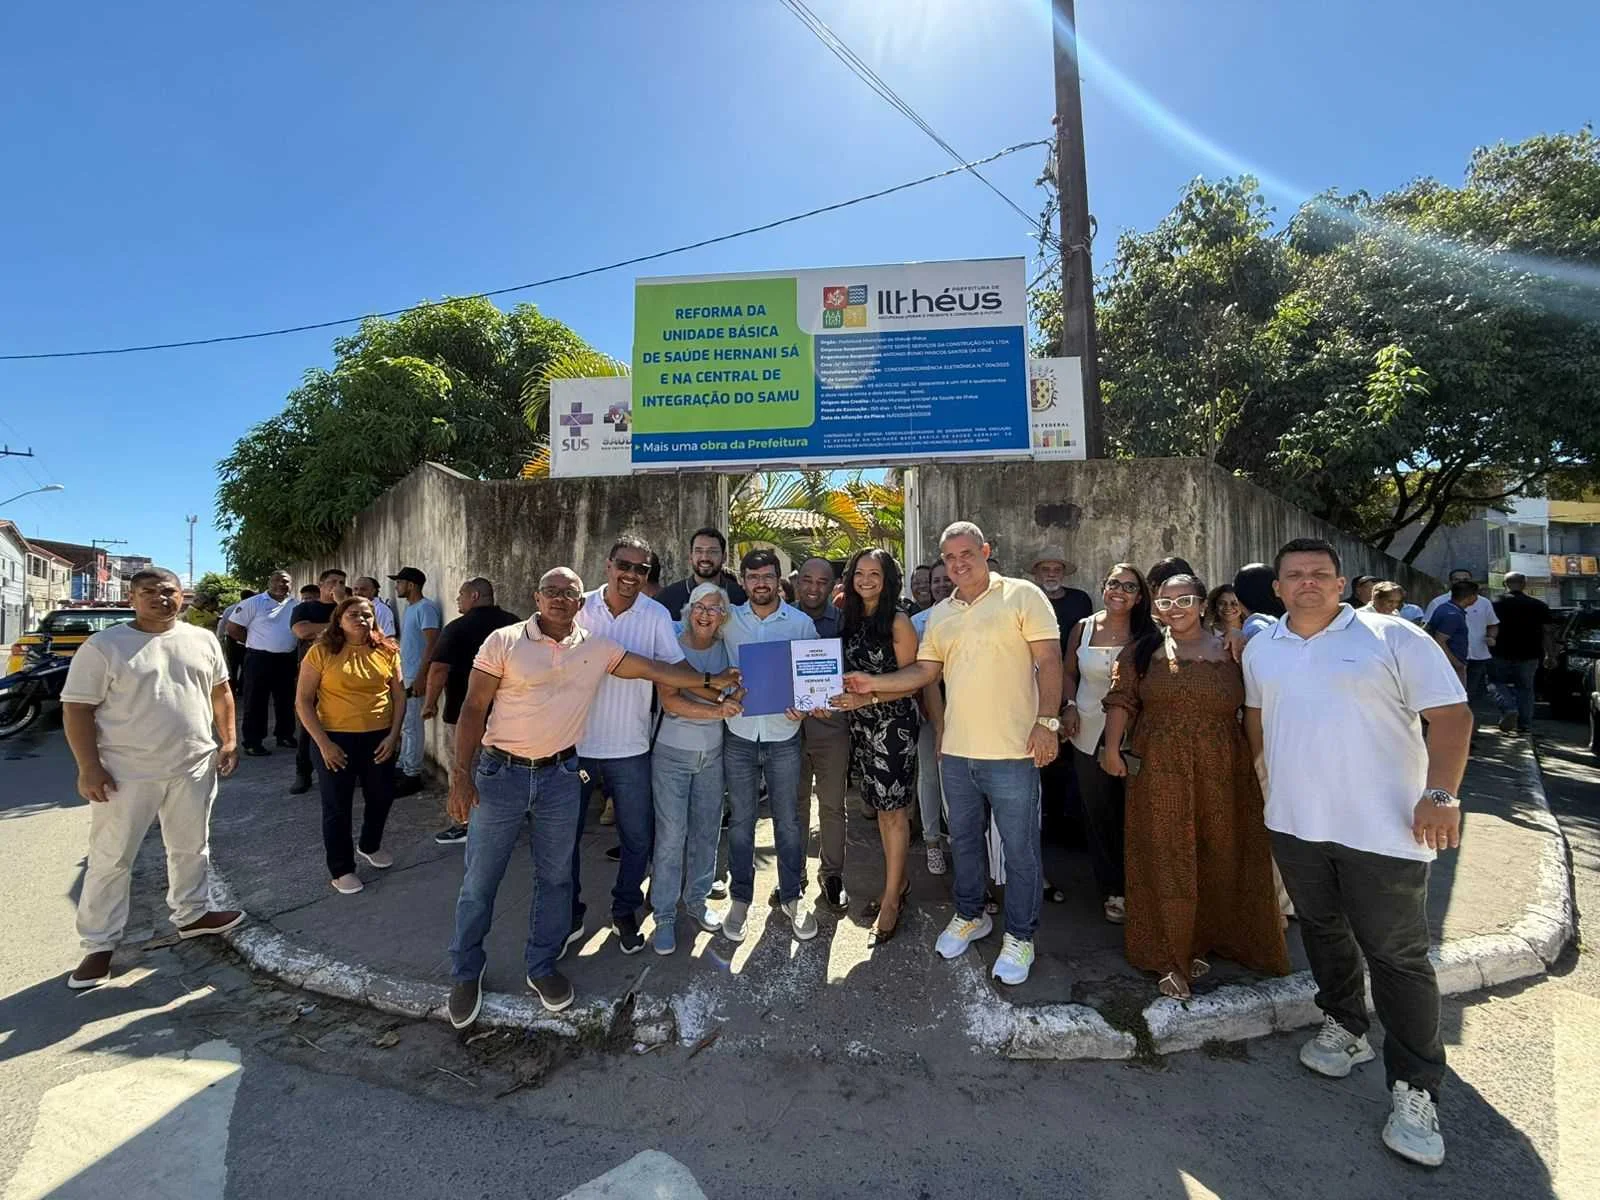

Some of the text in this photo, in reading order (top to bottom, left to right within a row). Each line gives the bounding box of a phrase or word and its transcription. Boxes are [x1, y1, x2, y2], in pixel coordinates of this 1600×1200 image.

[676, 304, 766, 320] REFORMA DA
[663, 324, 779, 340] UNIDADE BÁSICA
[643, 344, 800, 363] DE SAÚDE HERNANI SÁ
[660, 369, 781, 384] E NA CENTRAL DE
[642, 390, 799, 407] INTEGRAÇÃO DO SAMU
[562, 438, 590, 452] SUS
[643, 436, 808, 453] Mais uma obra da Prefeitura
